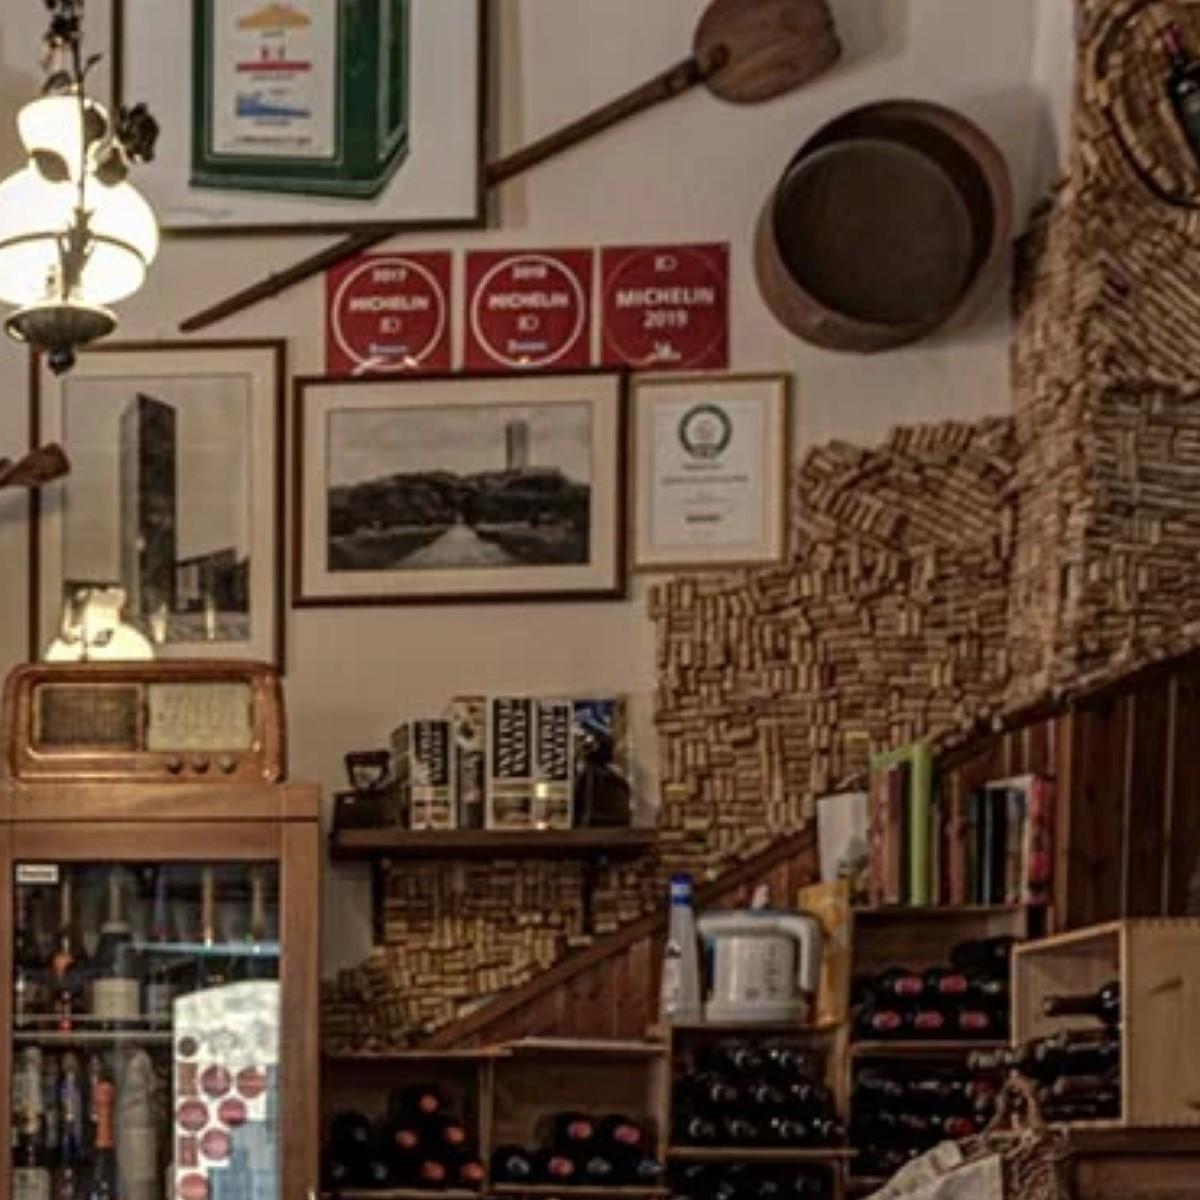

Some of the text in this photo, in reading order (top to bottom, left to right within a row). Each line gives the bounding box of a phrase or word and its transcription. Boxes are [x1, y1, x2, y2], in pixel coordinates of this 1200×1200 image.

[349, 296, 429, 311] MICHELIN
[489, 293, 568, 310] MICHELIN
[616, 287, 714, 308] MICHELIN
[644, 309, 688, 329] 2019
